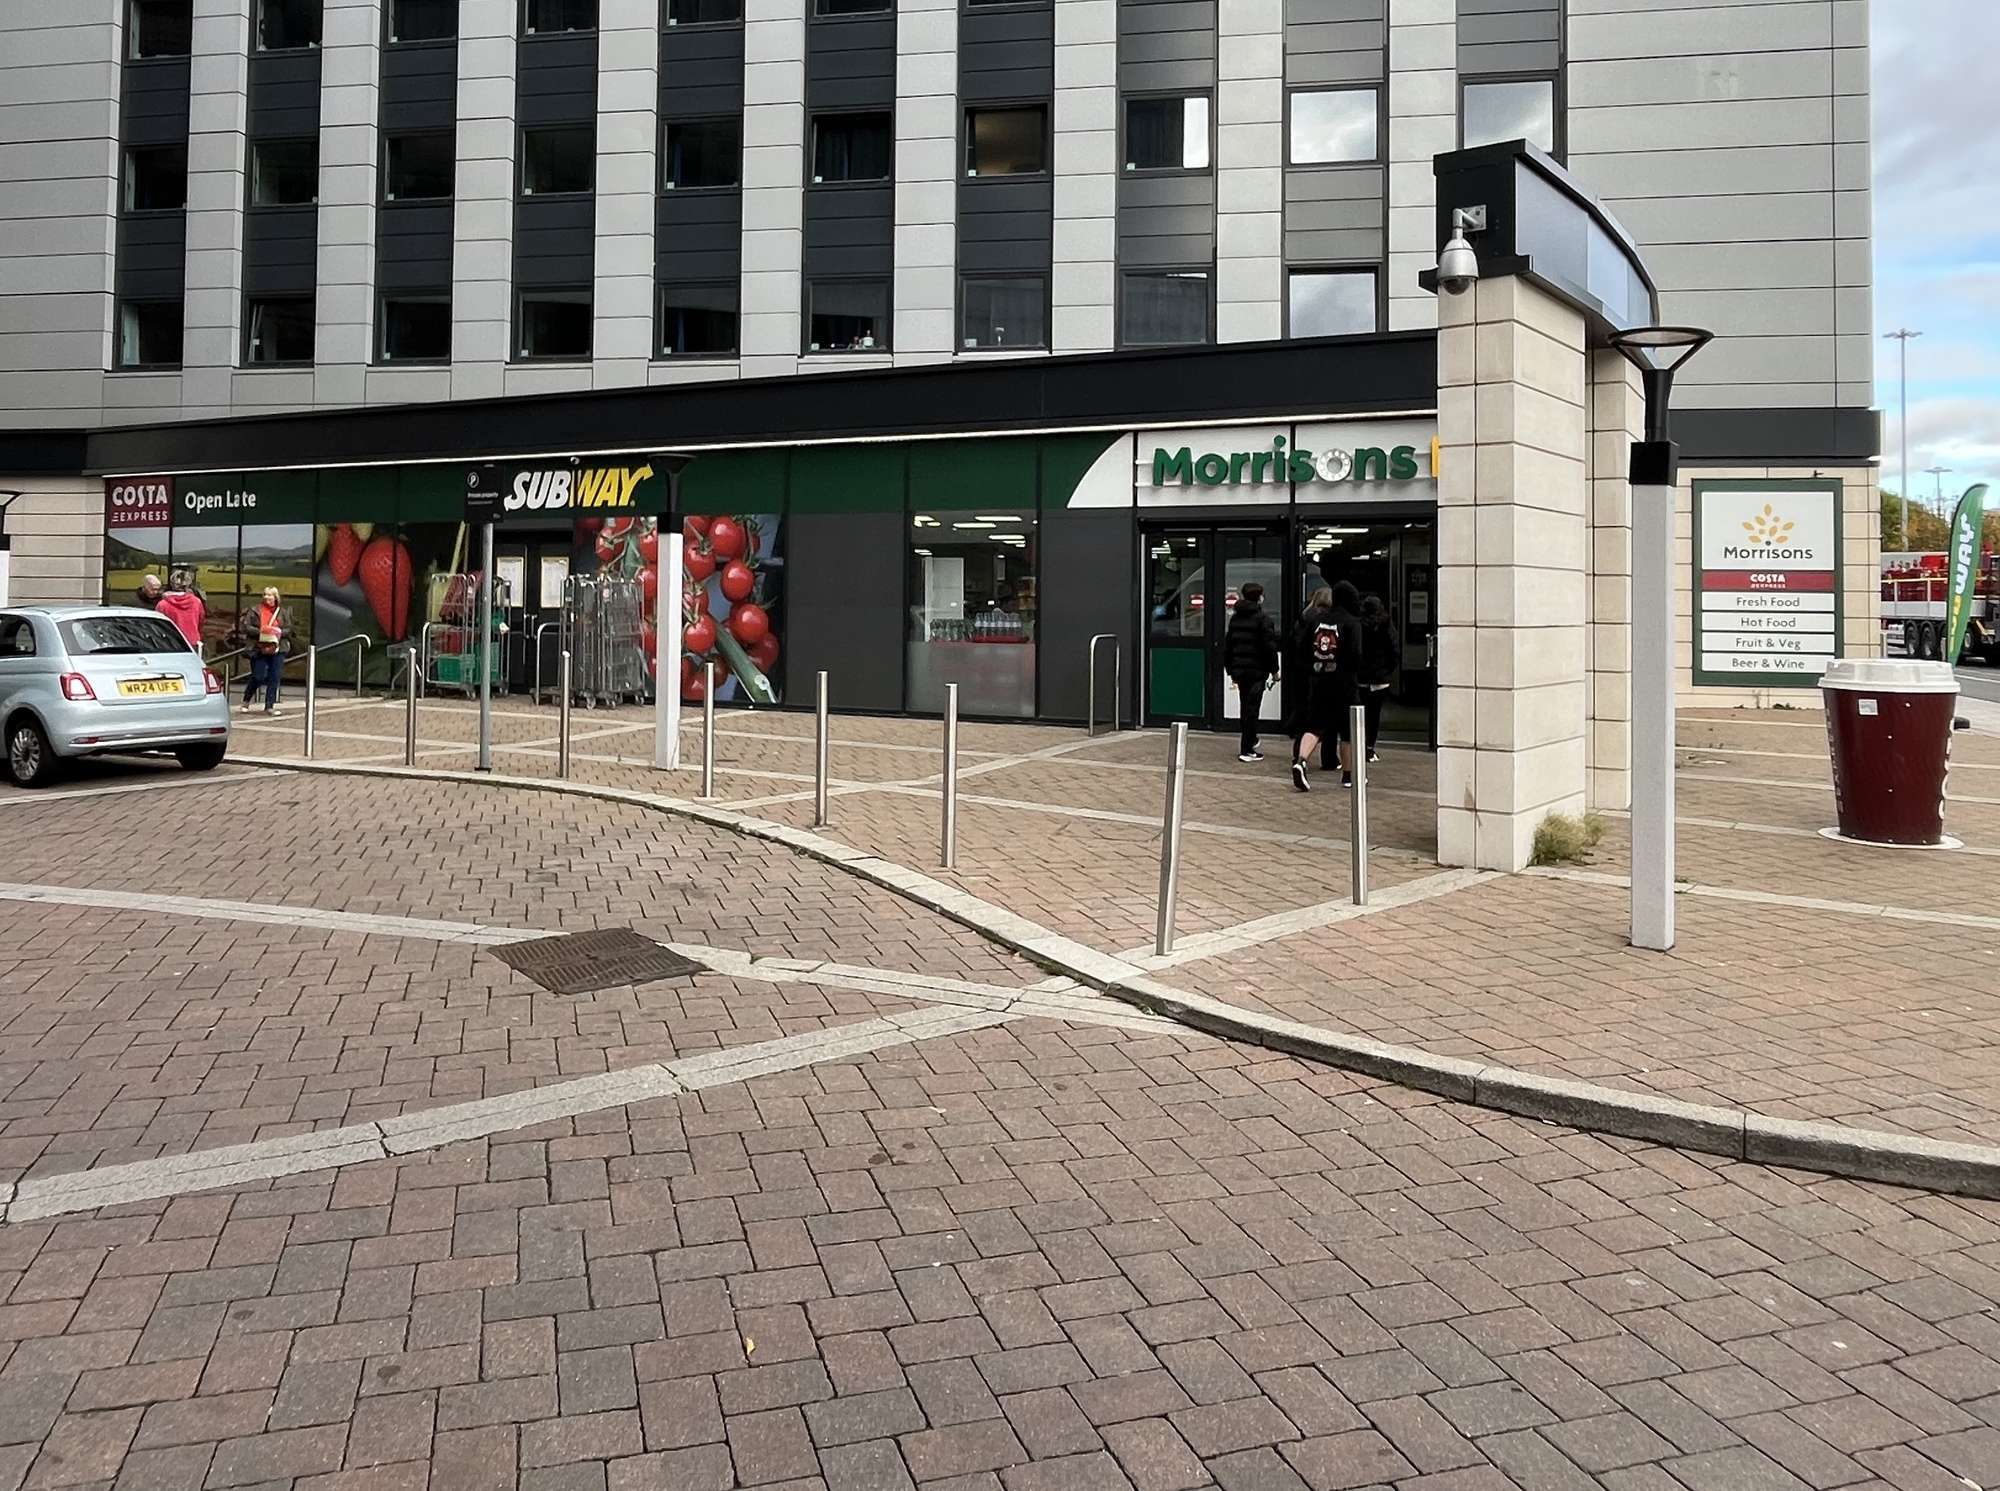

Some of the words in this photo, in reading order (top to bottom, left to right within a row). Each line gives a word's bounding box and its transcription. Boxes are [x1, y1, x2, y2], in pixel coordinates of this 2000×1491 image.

[504, 464, 654, 511] SUBWAY
[112, 484, 168, 508] COSTA
[185, 491, 222, 514] Open
[226, 490, 256, 508] Late
[120, 510, 168, 522] EXPRESS
[1724, 540, 1813, 560] Morrisons
[1750, 573, 1786, 583] COSTA
[1736, 596, 1767, 607] Fresh
[1770, 597, 1800, 607] Food
[1741, 617, 1762, 627] Hot
[1766, 617, 1796, 628] Food
[1736, 638, 1762, 648] Fruit
[1766, 638, 1774, 648] &
[1778, 638, 1801, 651] Veg
[1732, 658, 1758, 669] Beer
[1762, 658, 1770, 669] &
[1774, 658, 1805, 669] Wine
